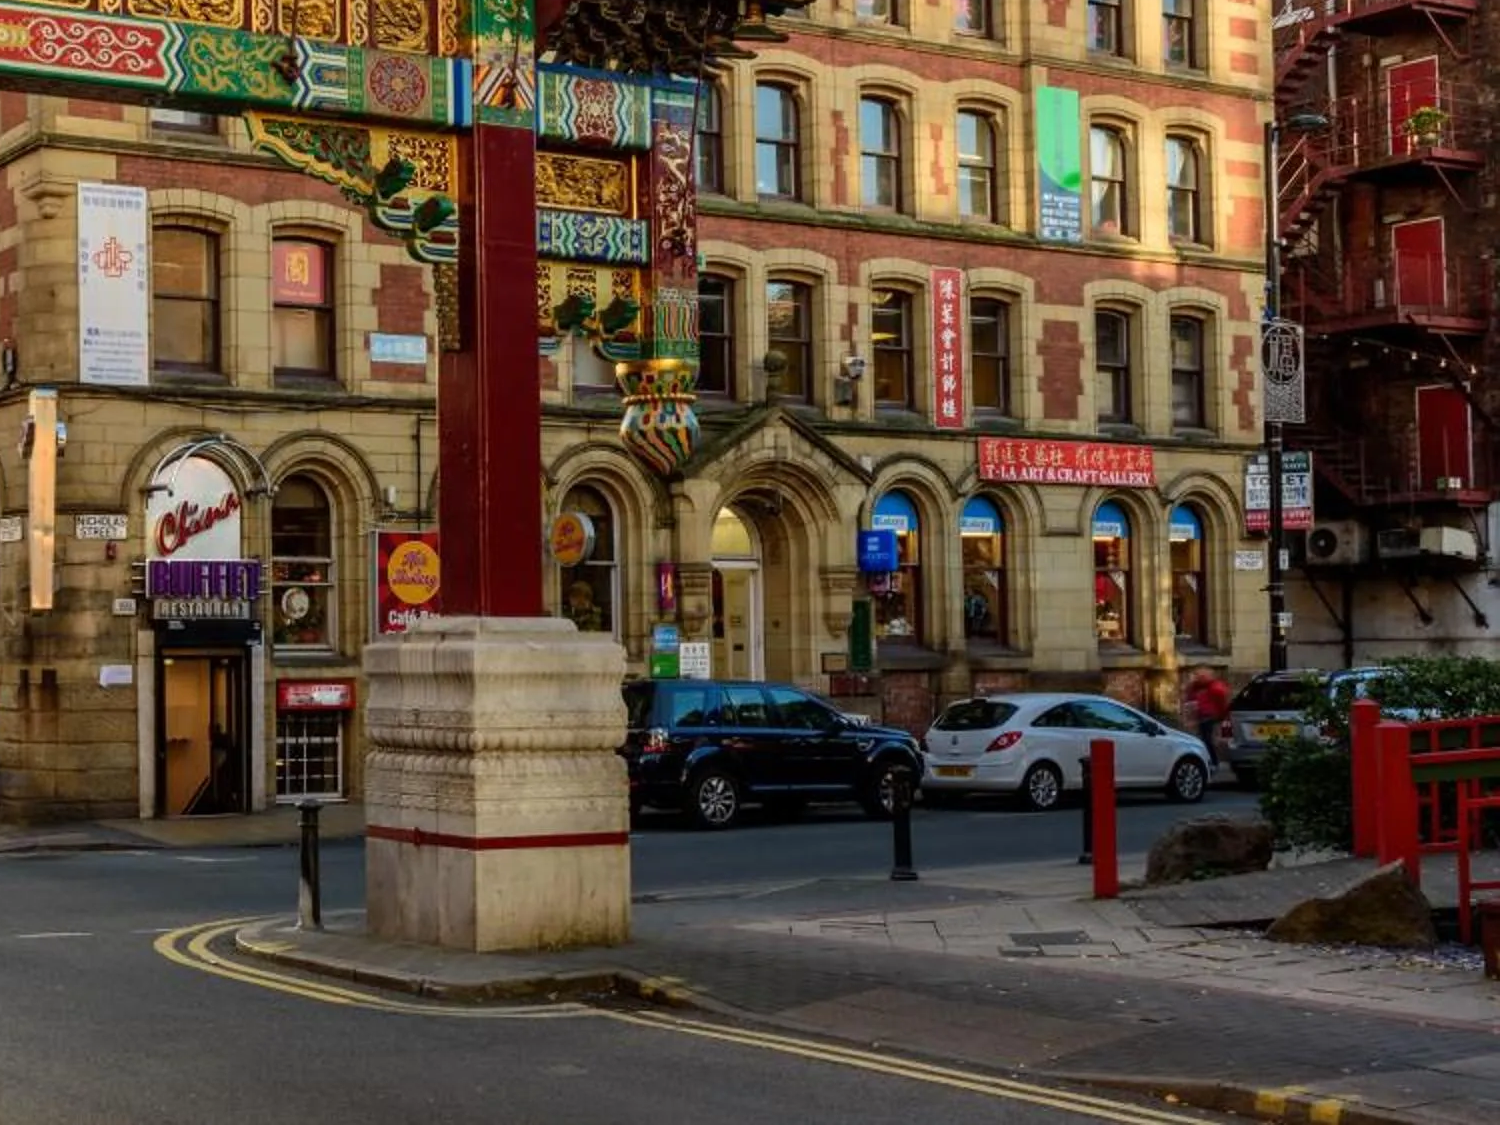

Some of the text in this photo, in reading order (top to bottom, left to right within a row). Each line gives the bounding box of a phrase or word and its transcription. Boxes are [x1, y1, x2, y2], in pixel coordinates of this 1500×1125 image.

[1020, 465, 1047, 481] ART
[1057, 467, 1099, 483] CRAFT
[1099, 470, 1152, 486] GALLERY
[77, 514, 127, 526] NICHOLAS
[81, 526, 119, 538] STREET
[150, 560, 260, 599] BUFFET
[161, 601, 250, 617] RESTAURANT
